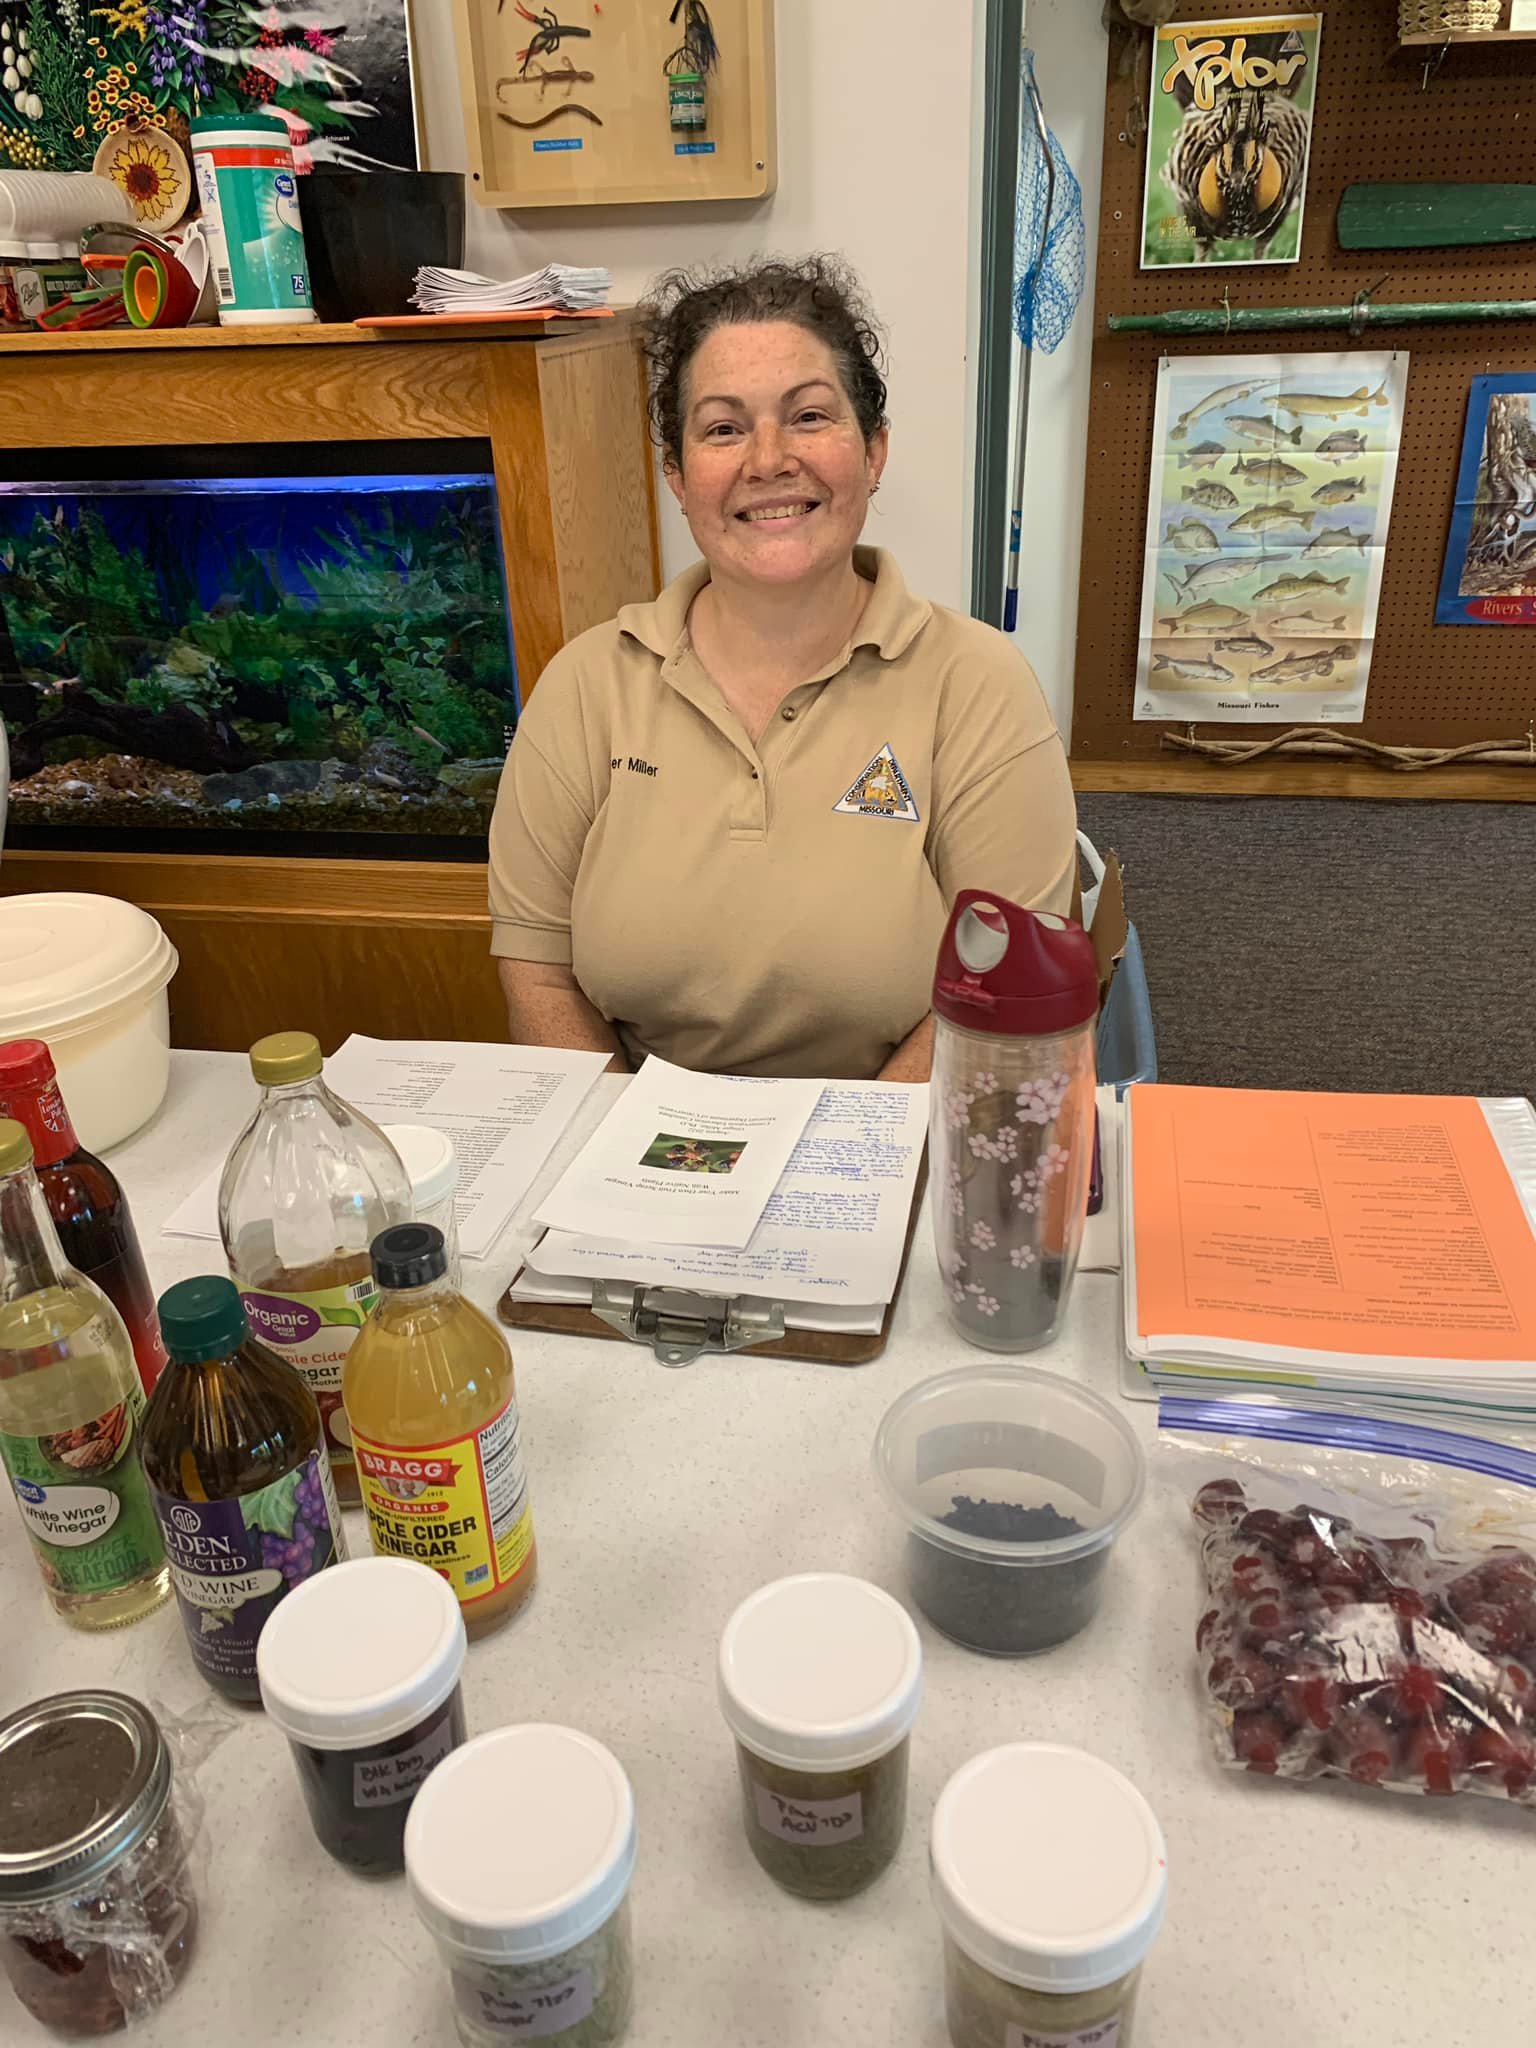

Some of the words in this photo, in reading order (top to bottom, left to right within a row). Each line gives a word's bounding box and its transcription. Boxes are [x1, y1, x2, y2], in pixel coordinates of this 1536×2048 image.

[1162, 35, 1308, 110] Xplor
[293, 276, 304, 289] 75
[1481, 600, 1522, 616] Rivers
[1217, 701, 1251, 710] Missouri
[1253, 701, 1280, 710] Fishes
[628, 757, 658, 777] Miller
[845, 757, 884, 802] CONSERVATION
[888, 759, 911, 802] DEPARTMENT
[859, 805, 894, 816] MISSOURI
[244, 1299, 311, 1326] Organic
[311, 1352, 346, 1364] Cide
[363, 1453, 443, 1478] BRAGG
[62, 1504, 105, 1521] Wine
[375, 1496, 440, 1512] ORGANIC
[43, 1514, 108, 1534] Vinegar
[413, 1516, 478, 1541] CIDER
[161, 1520, 232, 1556] EDEN
[376, 1527, 458, 1558] VINEGAR
[200, 1576, 260, 1595] WINE
[185, 1592, 235, 1605] VINEGAR
